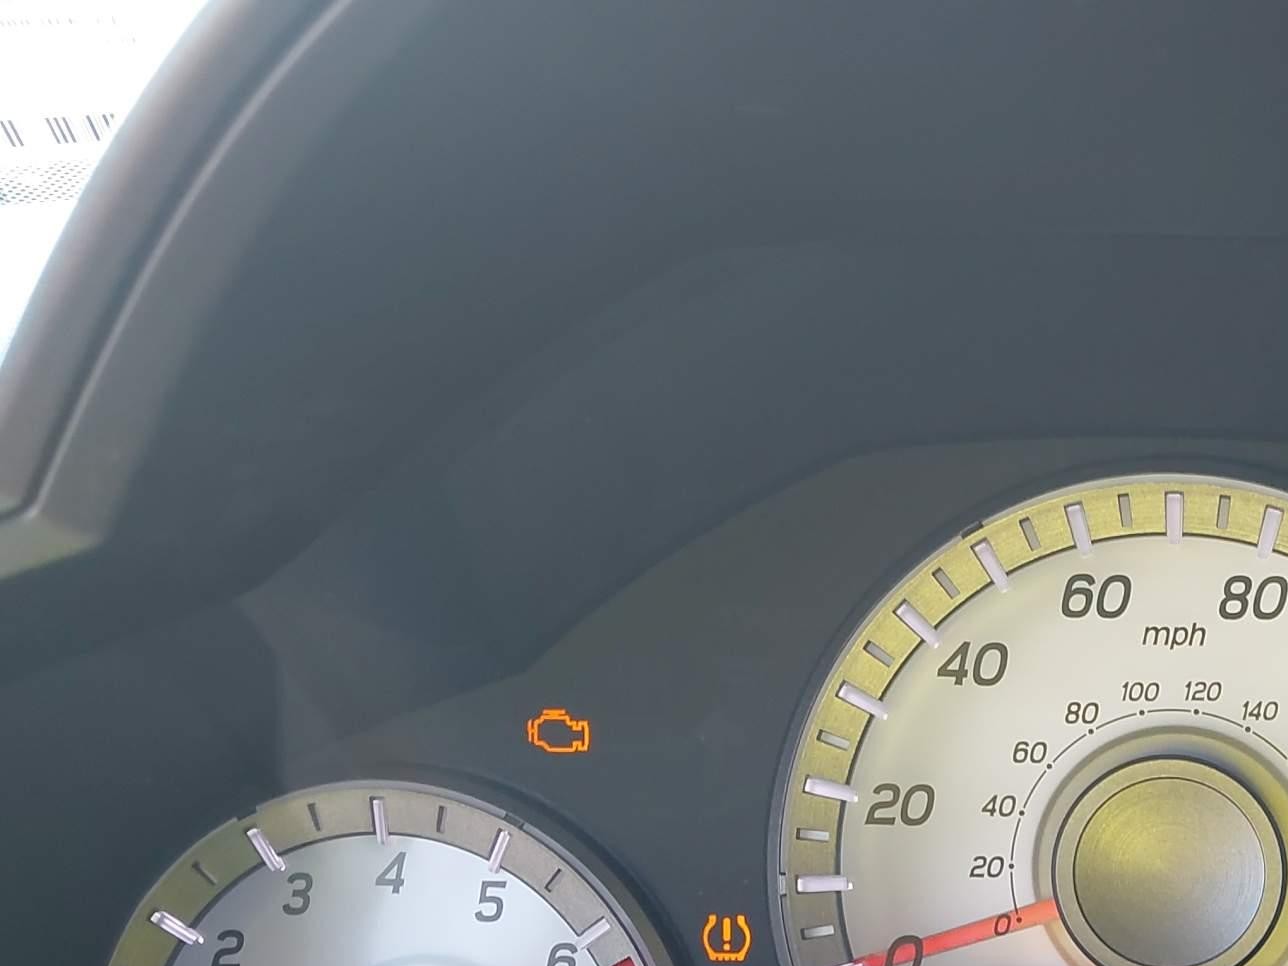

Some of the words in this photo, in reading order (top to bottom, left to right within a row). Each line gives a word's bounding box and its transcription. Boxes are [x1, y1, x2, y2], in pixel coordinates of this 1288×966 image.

[1061, 574, 1131, 619] 60
[1219, 576, 1288, 621] 80
[1142, 622, 1206, 649] mph
[937, 642, 1008, 686] 40
[1121, 681, 1159, 702] 100
[1184, 681, 1221, 702] 120
[1065, 702, 1098, 724] 80
[1241, 701, 1278, 721] 140
[1012, 742, 1046, 764] 60
[865, 784, 934, 826] 20
[981, 796, 1016, 818] 40
[375, 851, 407, 894] 4
[969, 856, 1004, 878] 20
[282, 872, 314, 915] 3
[474, 880, 506, 922] 5
[993, 912, 1011, 936] 0
